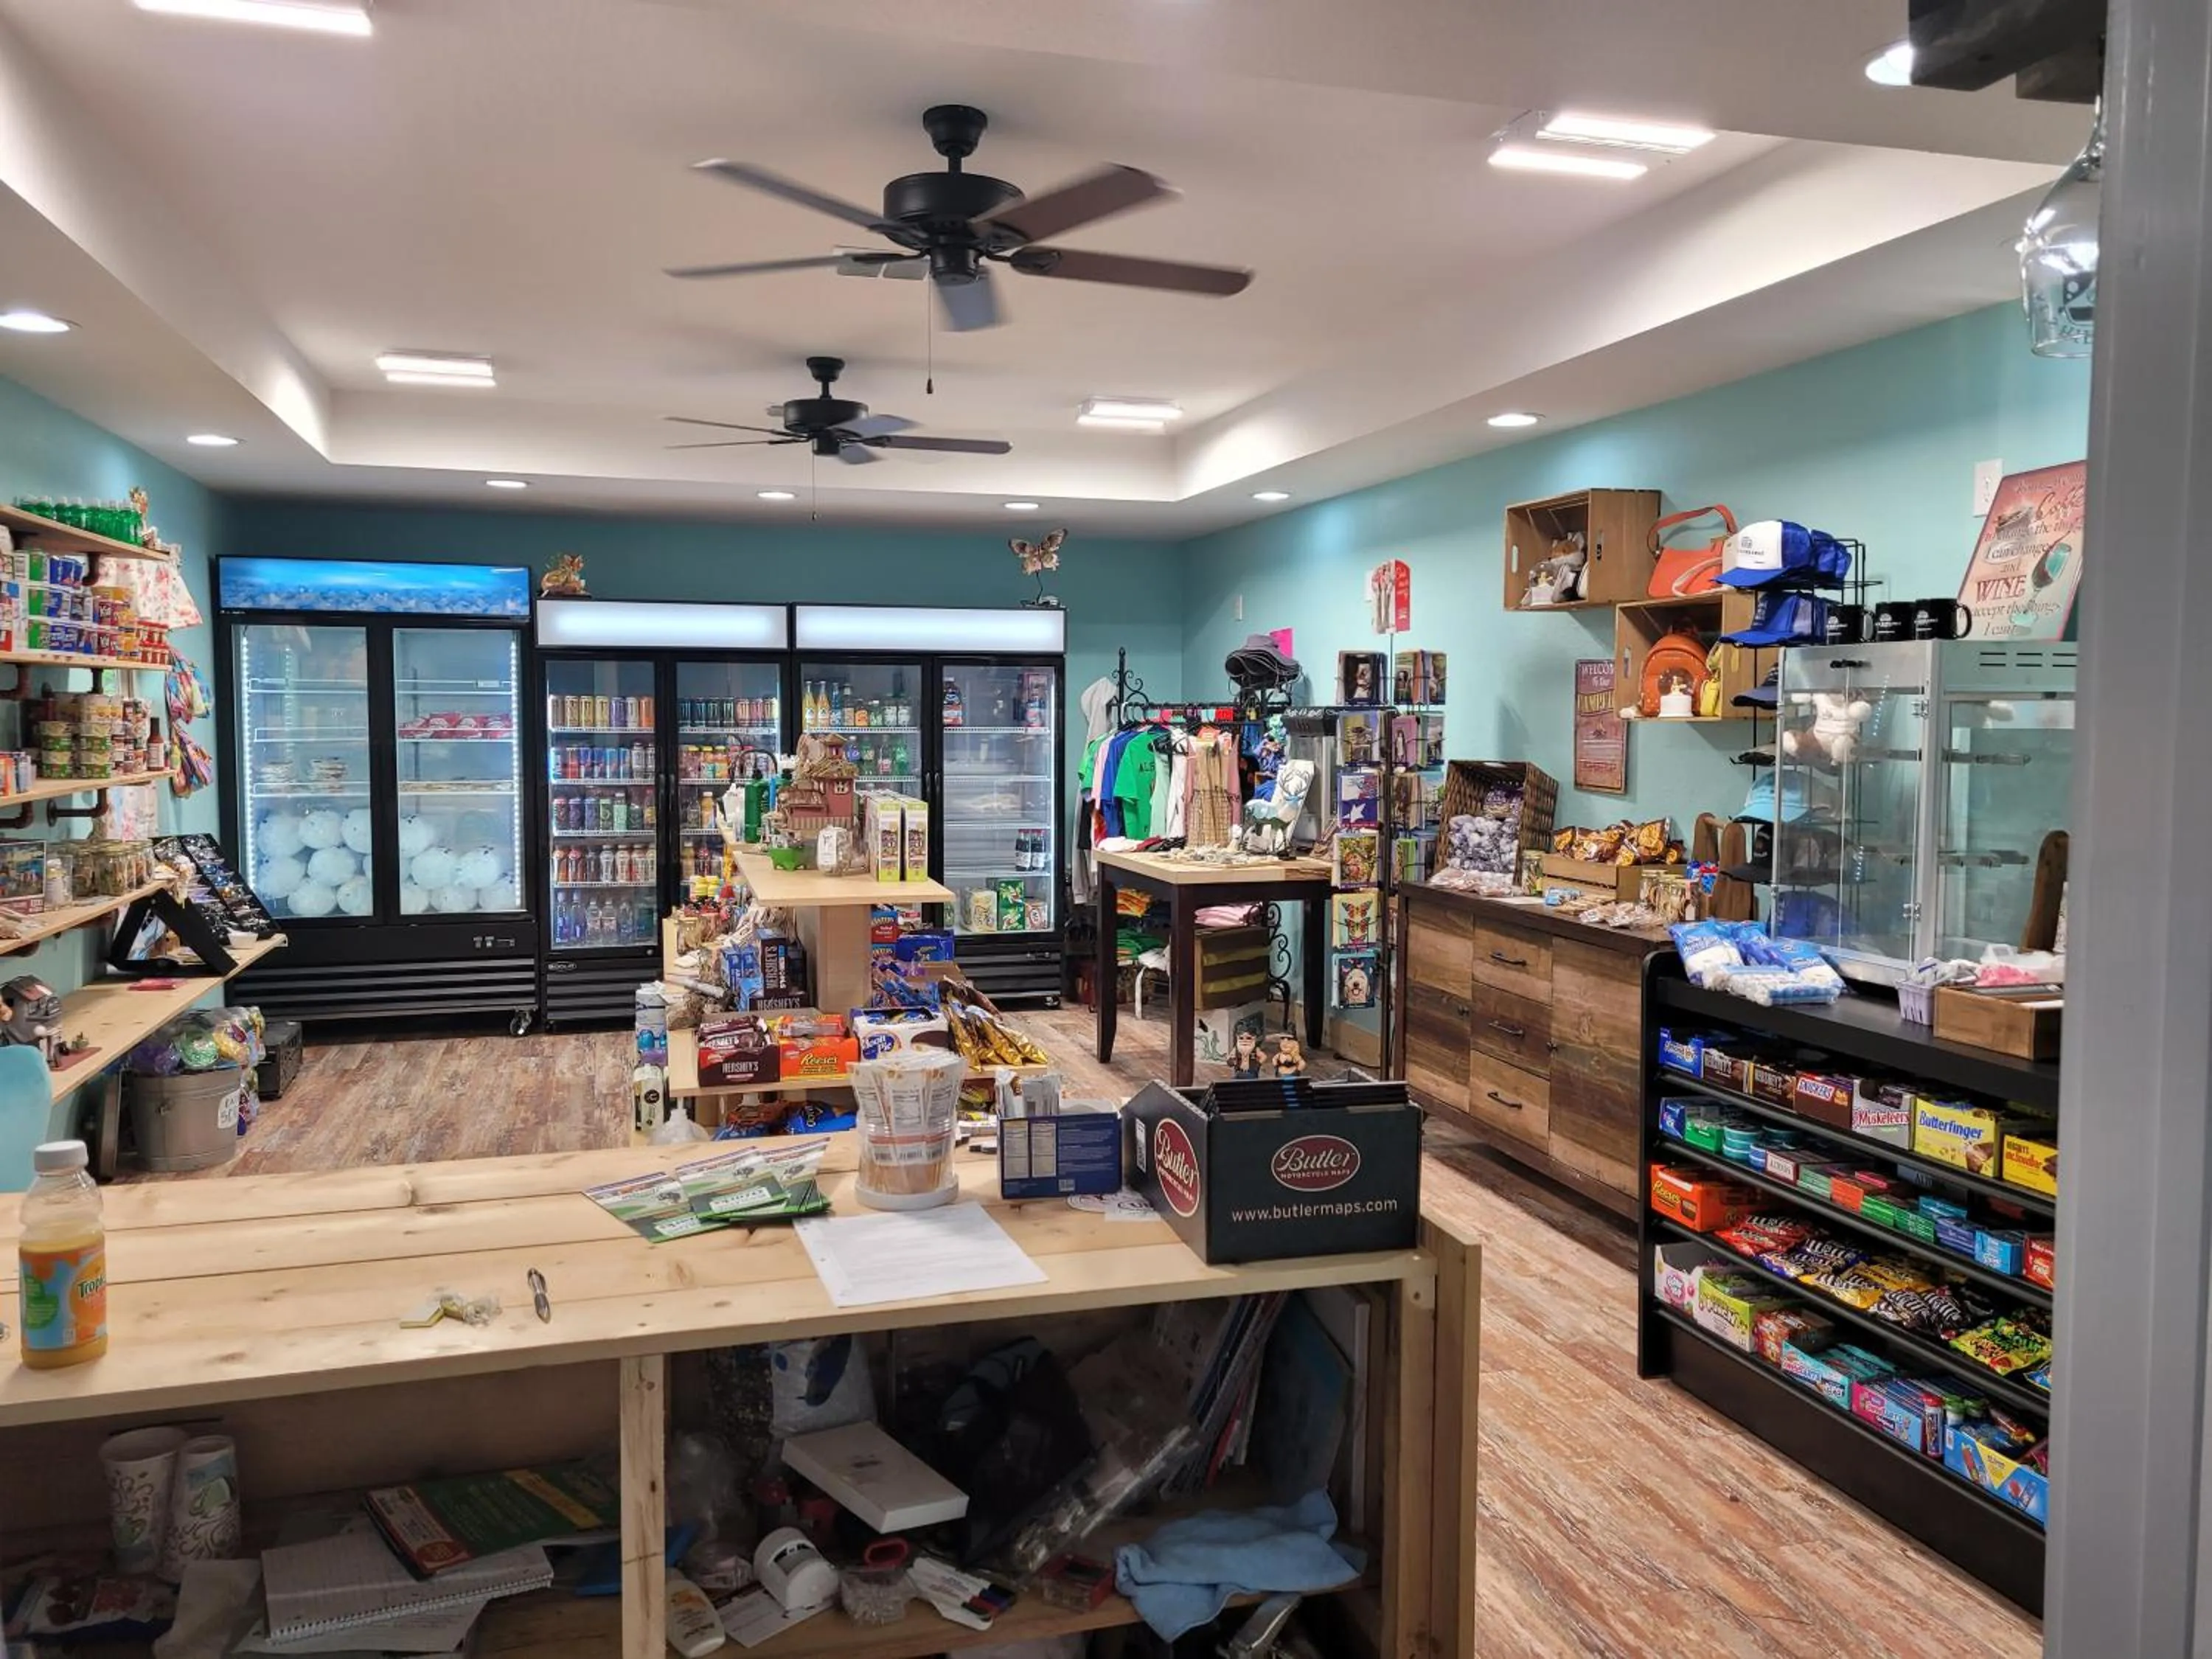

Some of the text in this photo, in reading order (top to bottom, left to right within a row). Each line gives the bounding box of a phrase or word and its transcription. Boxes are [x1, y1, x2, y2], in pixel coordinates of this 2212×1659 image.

[1976, 575, 2027, 603] WINE
[1580, 663, 1614, 676] WELCO
[723, 1061, 759, 1074] HERSHEY'S
[1798, 1078, 1834, 1099] SNICKERS
[1858, 1110, 1910, 1126] Musketeers
[1919, 1110, 1983, 1139] Butterfinger
[1158, 1129, 1194, 1189] Butler
[1276, 1147, 1350, 1171] Butler
[1232, 1198, 1397, 1222] www.butlermaps.com
[78, 1274, 105, 1298] Tropi
